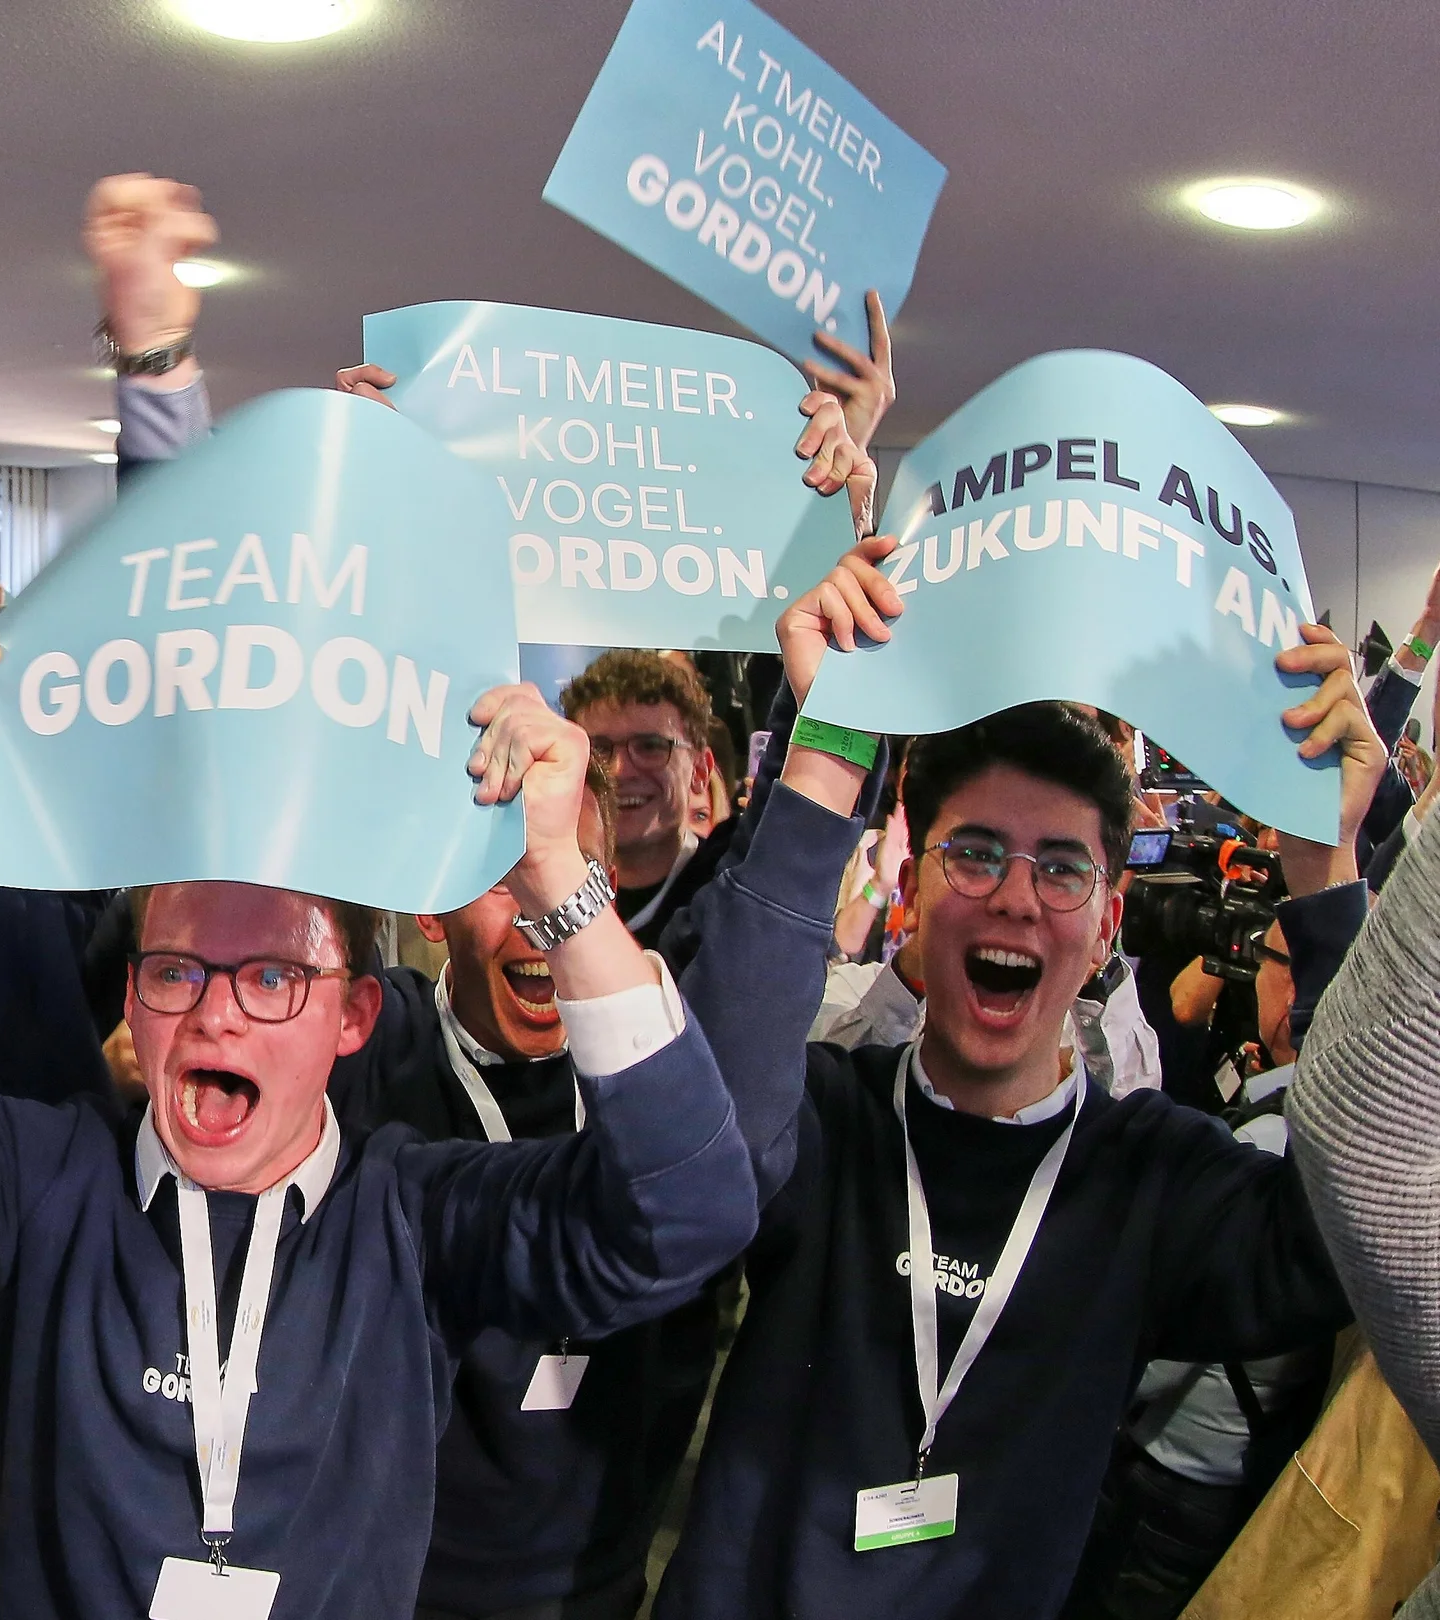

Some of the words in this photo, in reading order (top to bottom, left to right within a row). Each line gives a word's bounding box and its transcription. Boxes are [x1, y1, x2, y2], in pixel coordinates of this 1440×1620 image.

[696, 20, 885, 193] ALTMEIER.
[723, 91, 834, 208] KOHL.
[694, 128, 827, 264] VOGEL.
[626, 153, 841, 333] GORDON.
[447, 343, 754, 421] ALTMEIER.
[517, 414, 698, 473] KOHL.
[496, 475, 724, 536] VOGEL.
[882, 499, 1205, 596] ZUKUNFT
[924, 437, 1141, 517] AMPEL
[1158, 463, 1291, 593] AUS.
[120, 532, 369, 618] TEAM
[508, 532, 789, 600] ORDON.
[19, 624, 451, 759] GORDON
[896, 1251, 992, 1299] GRDO
[142, 1367, 193, 1403] GOR
